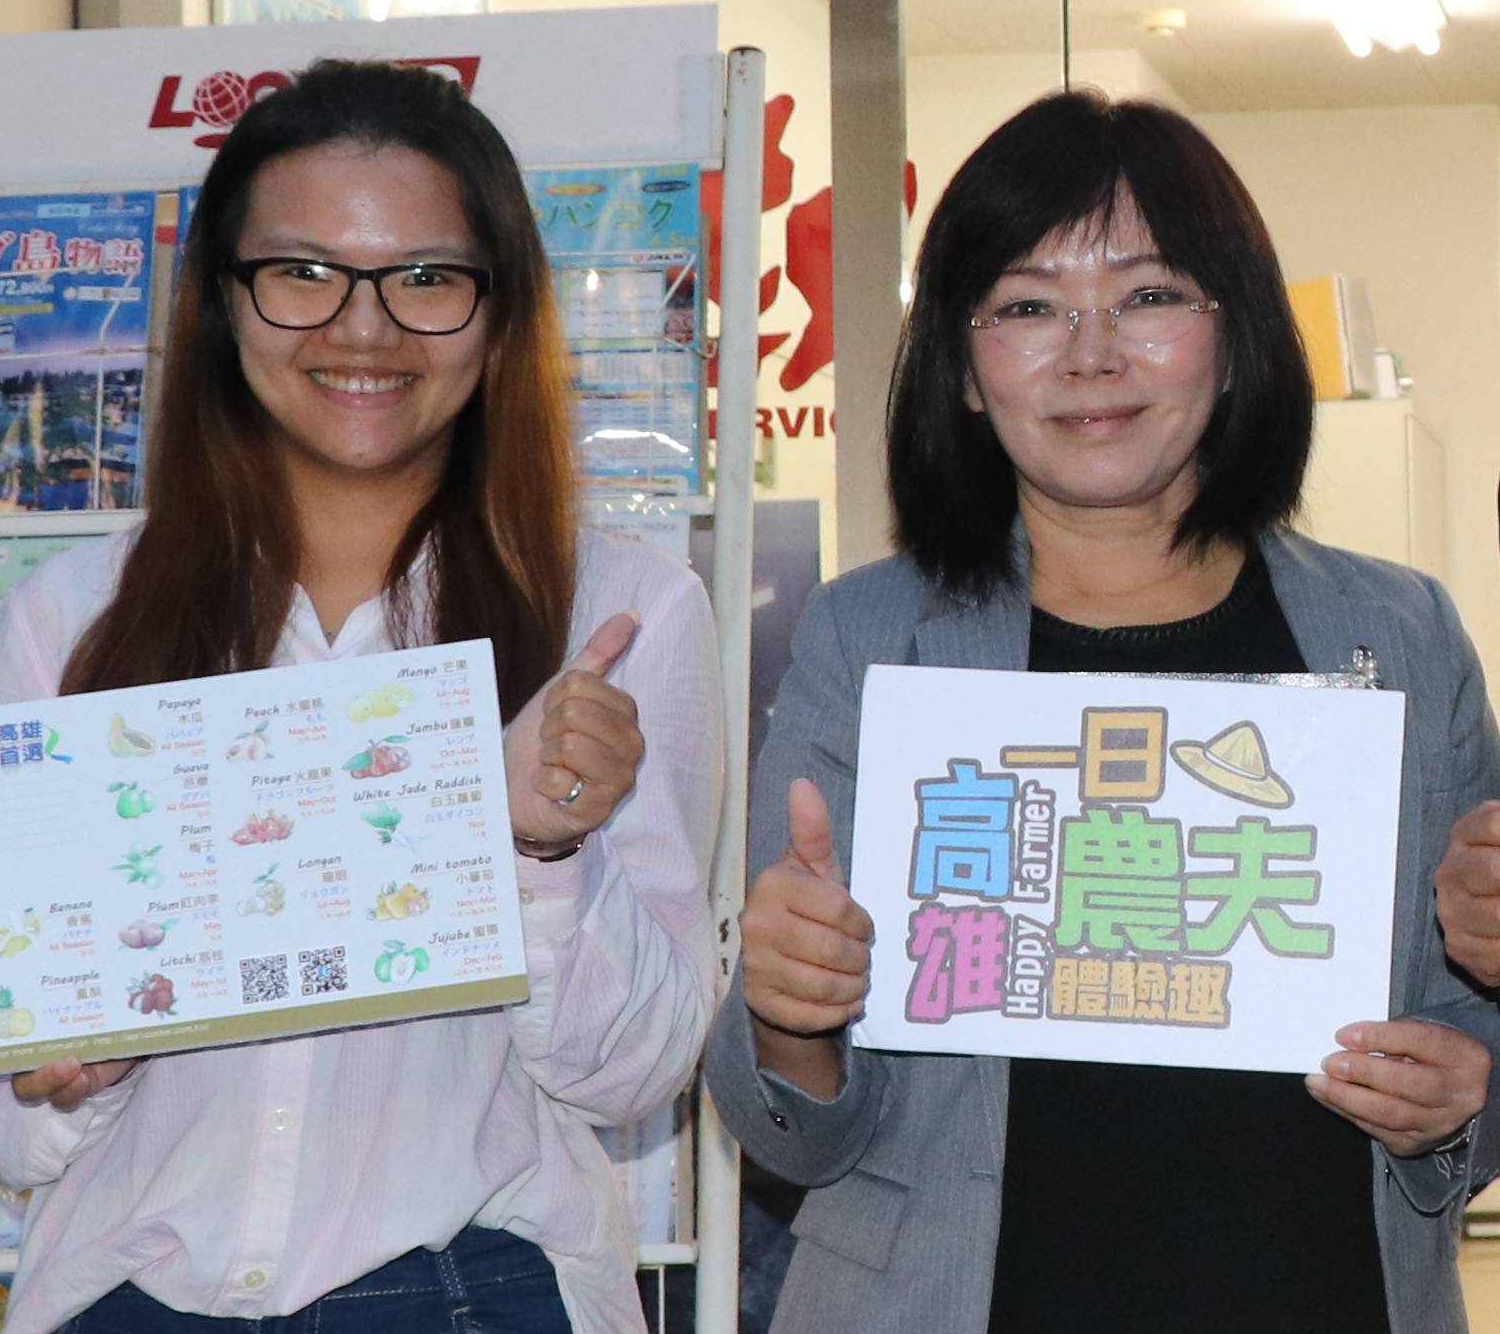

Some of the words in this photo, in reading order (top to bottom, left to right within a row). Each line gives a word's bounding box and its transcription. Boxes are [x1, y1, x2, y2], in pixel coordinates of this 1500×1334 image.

[397, 666, 438, 679] Mango
[158, 698, 202, 710] Papaya
[245, 705, 280, 718] Peach
[179, 712, 204, 724] 木瓜
[405, 722, 449, 736] Jambu
[0, 742, 45, 766] 首選
[1000, 706, 1168, 804] 一日
[173, 763, 210, 775] Guava
[251, 774, 291, 787] Pitaya
[353, 788, 391, 803] White
[396, 783, 428, 796] Jade
[434, 775, 483, 790] Raddish
[180, 825, 213, 836] Plum
[1013, 779, 1057, 903] Farmer
[298, 855, 342, 870] Longan
[411, 863, 439, 875] Mini
[445, 855, 494, 869] tomato
[1054, 804, 1335, 960] 農夫
[905, 758, 1019, 1024] 高雄
[49, 900, 93, 914] Banana
[148, 902, 180, 914] Plum
[428, 931, 471, 946] Jujube
[160, 954, 197, 967] Litchi
[1003, 913, 1051, 1019] Happy
[40, 971, 101, 987] Pineapple
[1046, 957, 1233, 1028] 體驗趣
